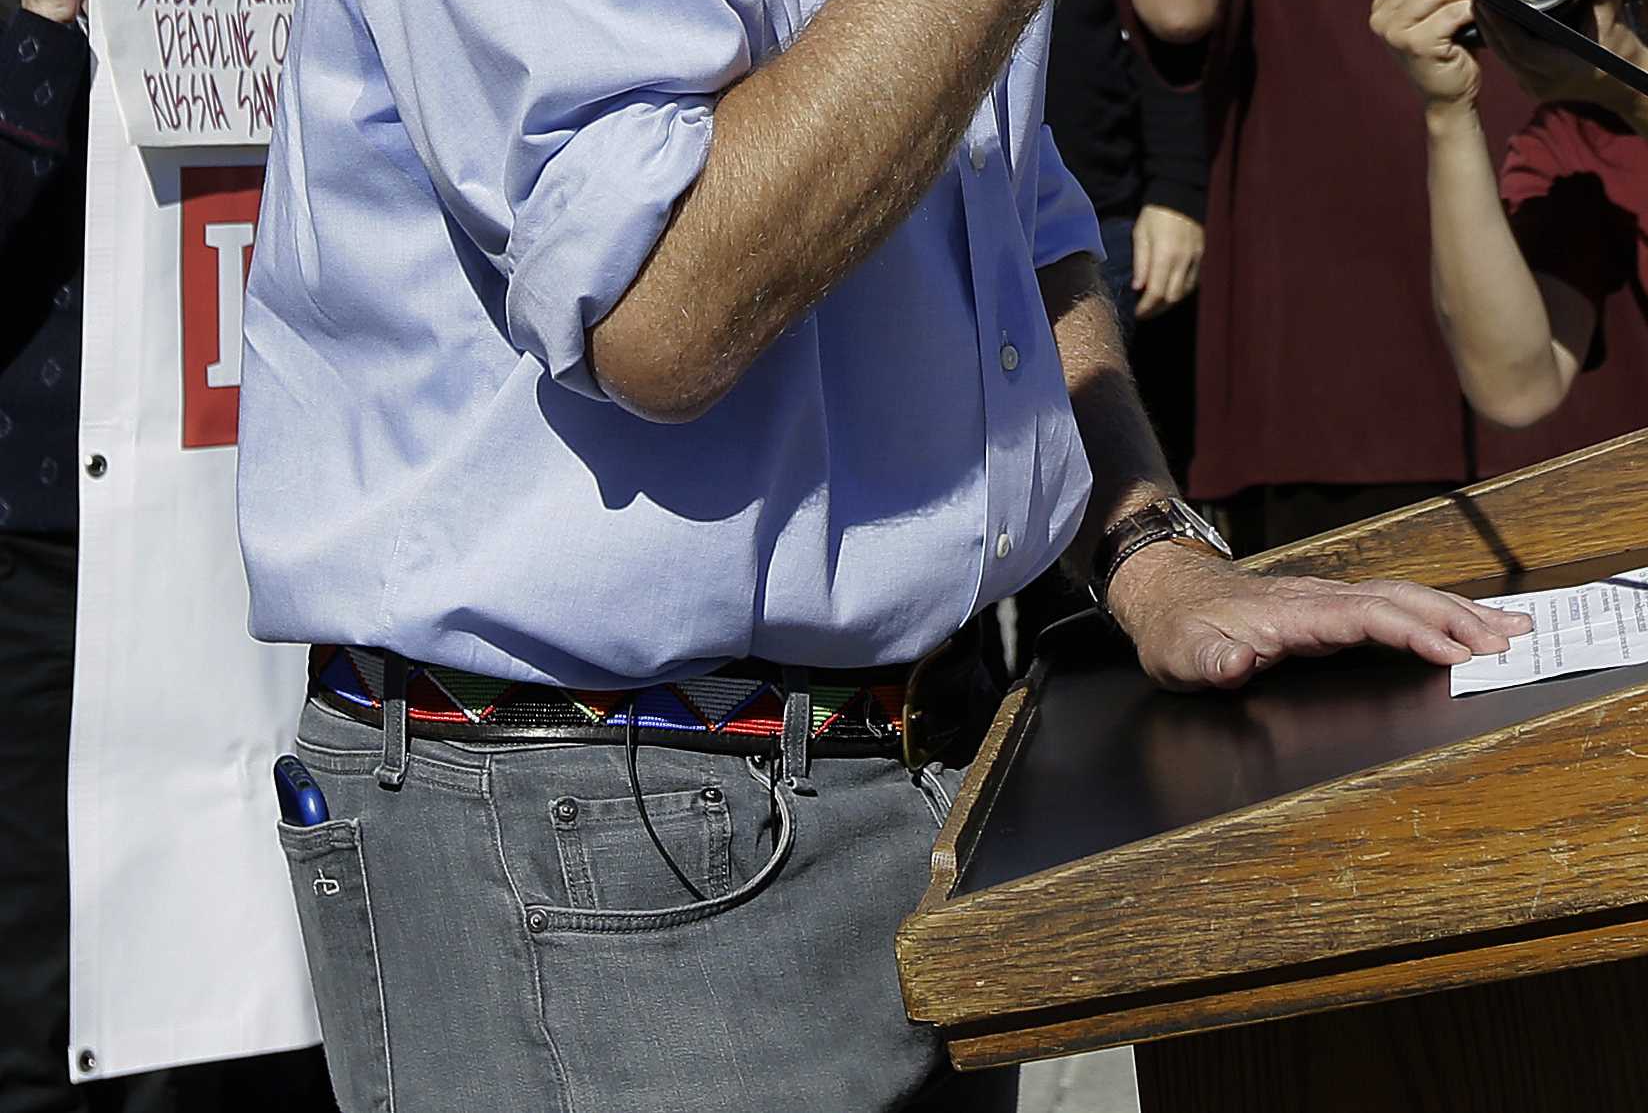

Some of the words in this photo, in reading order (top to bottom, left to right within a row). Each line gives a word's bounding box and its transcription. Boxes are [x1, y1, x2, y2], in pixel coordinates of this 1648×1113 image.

[154, 8, 257, 70] DEADLINE
[272, 13, 293, 65] O
[143, 68, 232, 133] RUSSIA
[236, 65, 282, 138] SAN
